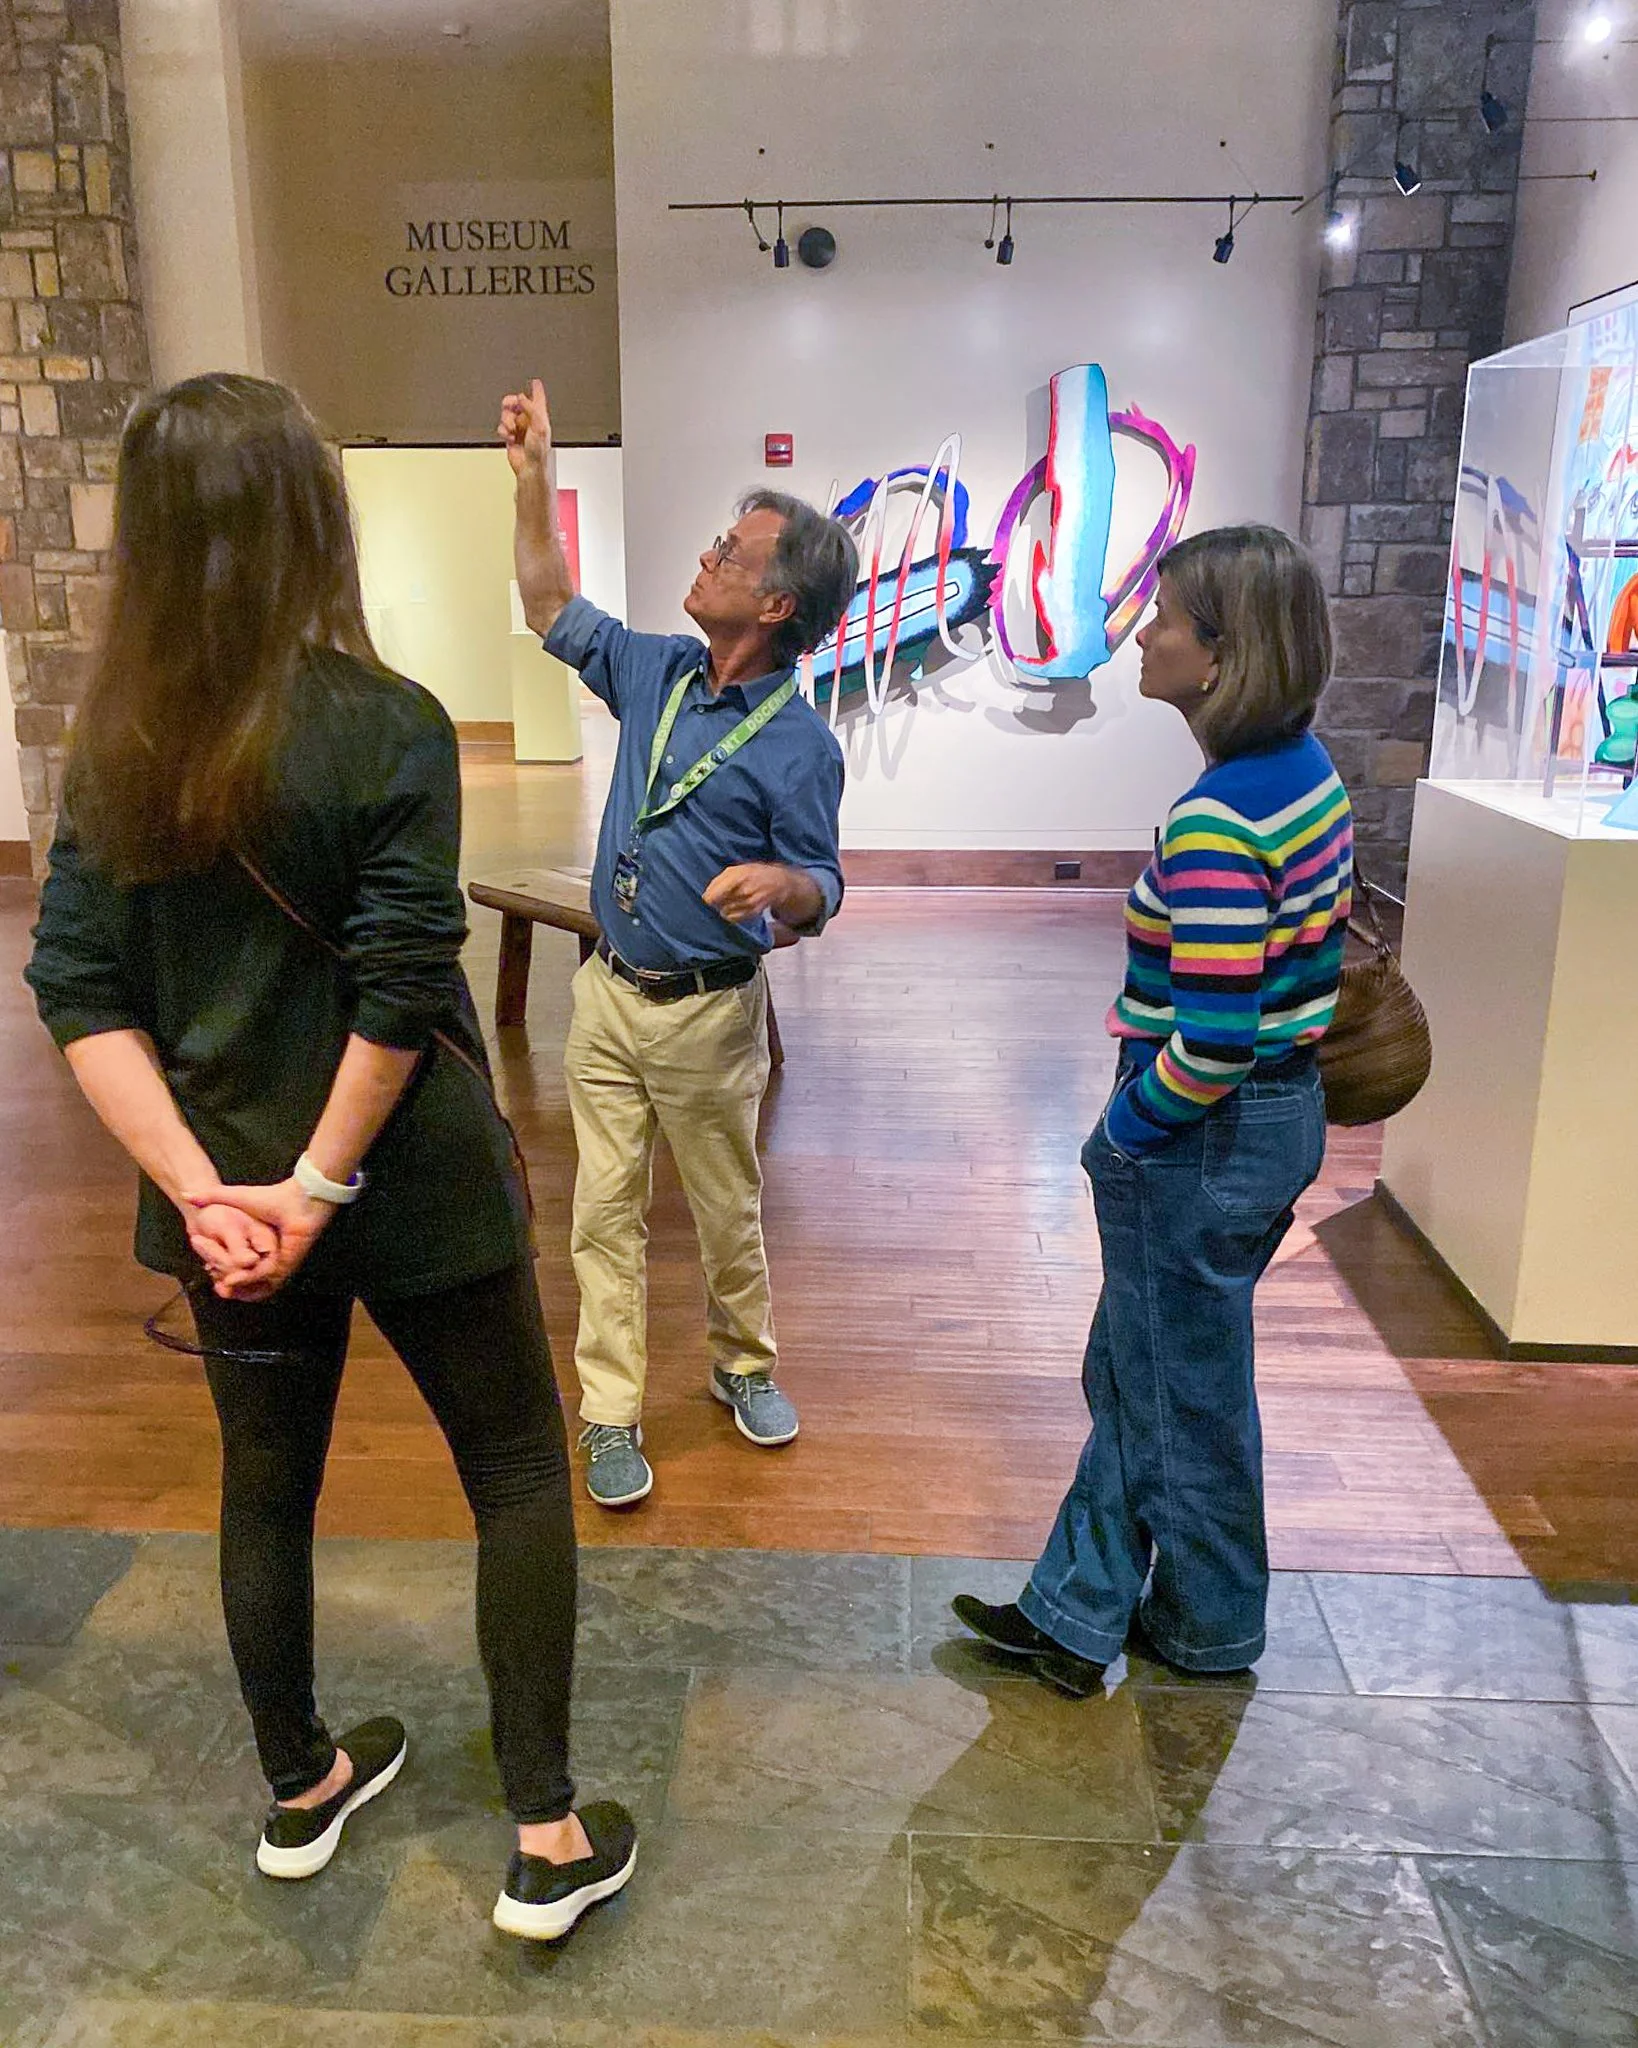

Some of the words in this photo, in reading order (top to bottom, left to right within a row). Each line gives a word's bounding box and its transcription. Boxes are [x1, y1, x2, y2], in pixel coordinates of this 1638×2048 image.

[405, 220, 571, 252] MUSEUM
[385, 264, 596, 297] GALLERIES
[745, 689, 788, 731] DOCENT
